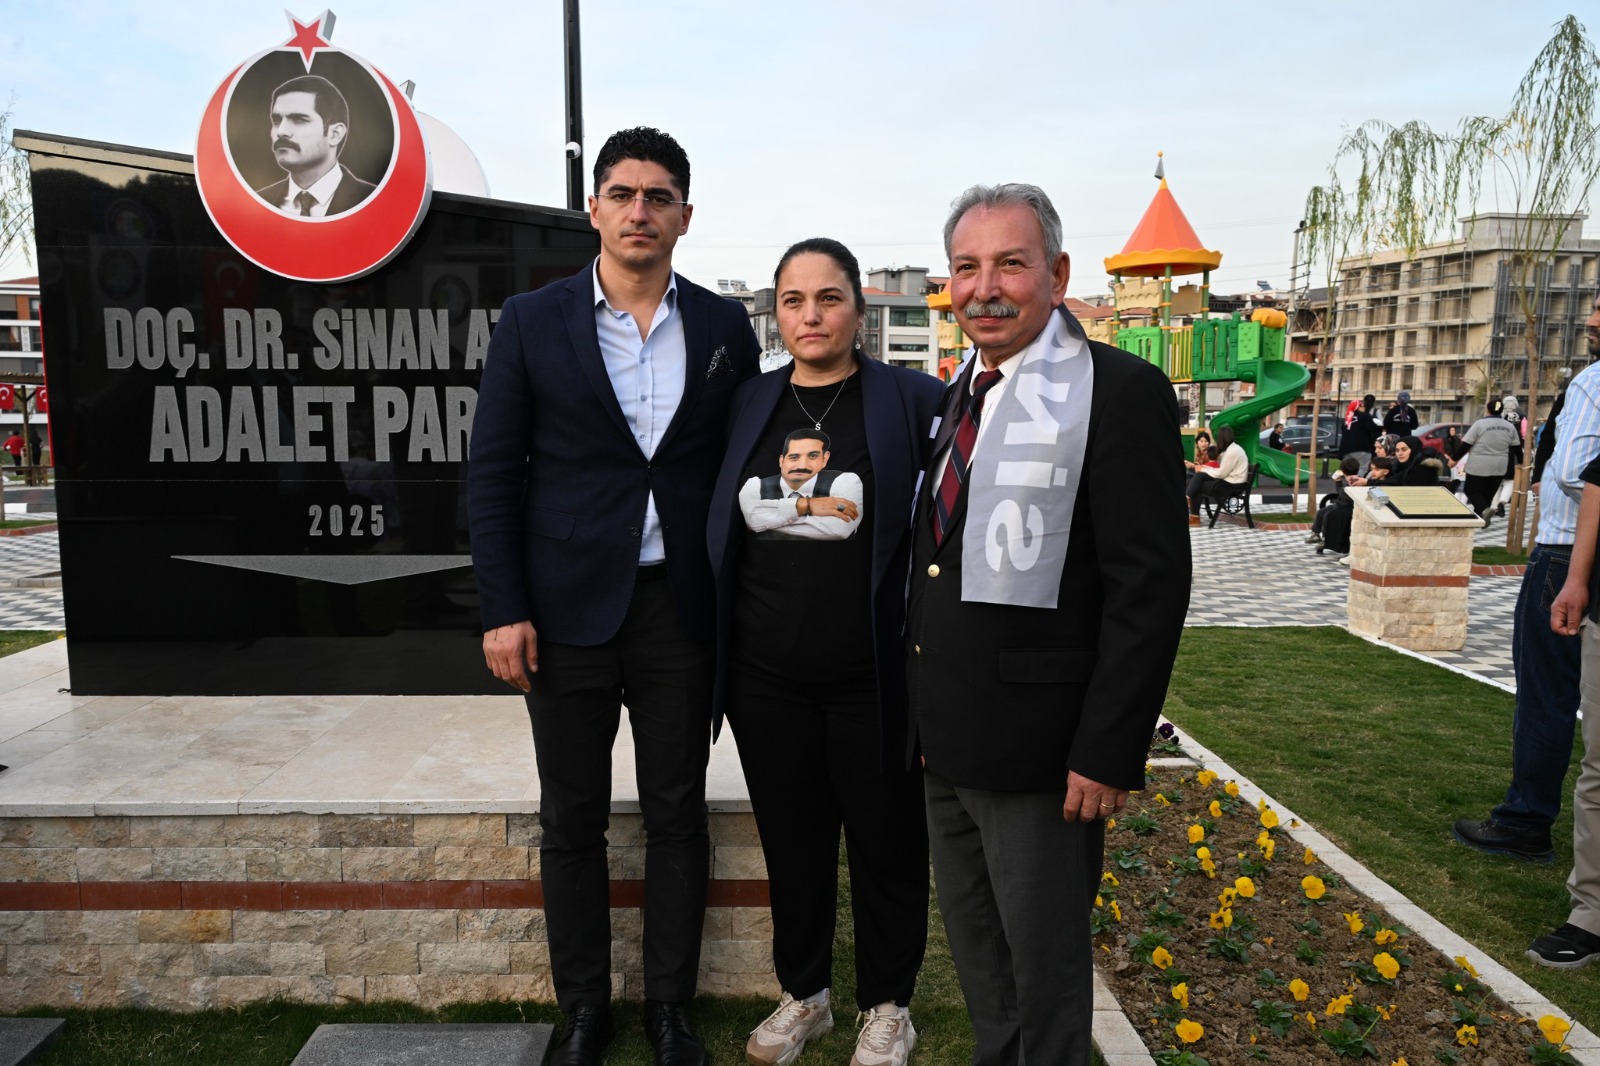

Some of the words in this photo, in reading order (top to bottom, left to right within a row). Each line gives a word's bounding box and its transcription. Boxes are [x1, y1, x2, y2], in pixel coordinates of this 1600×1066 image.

[104, 307, 210, 378] DOÇ.
[223, 308, 299, 370] DR.
[464, 308, 503, 370] A
[149, 385, 355, 462] ADALET
[308, 504, 384, 537] 2025
